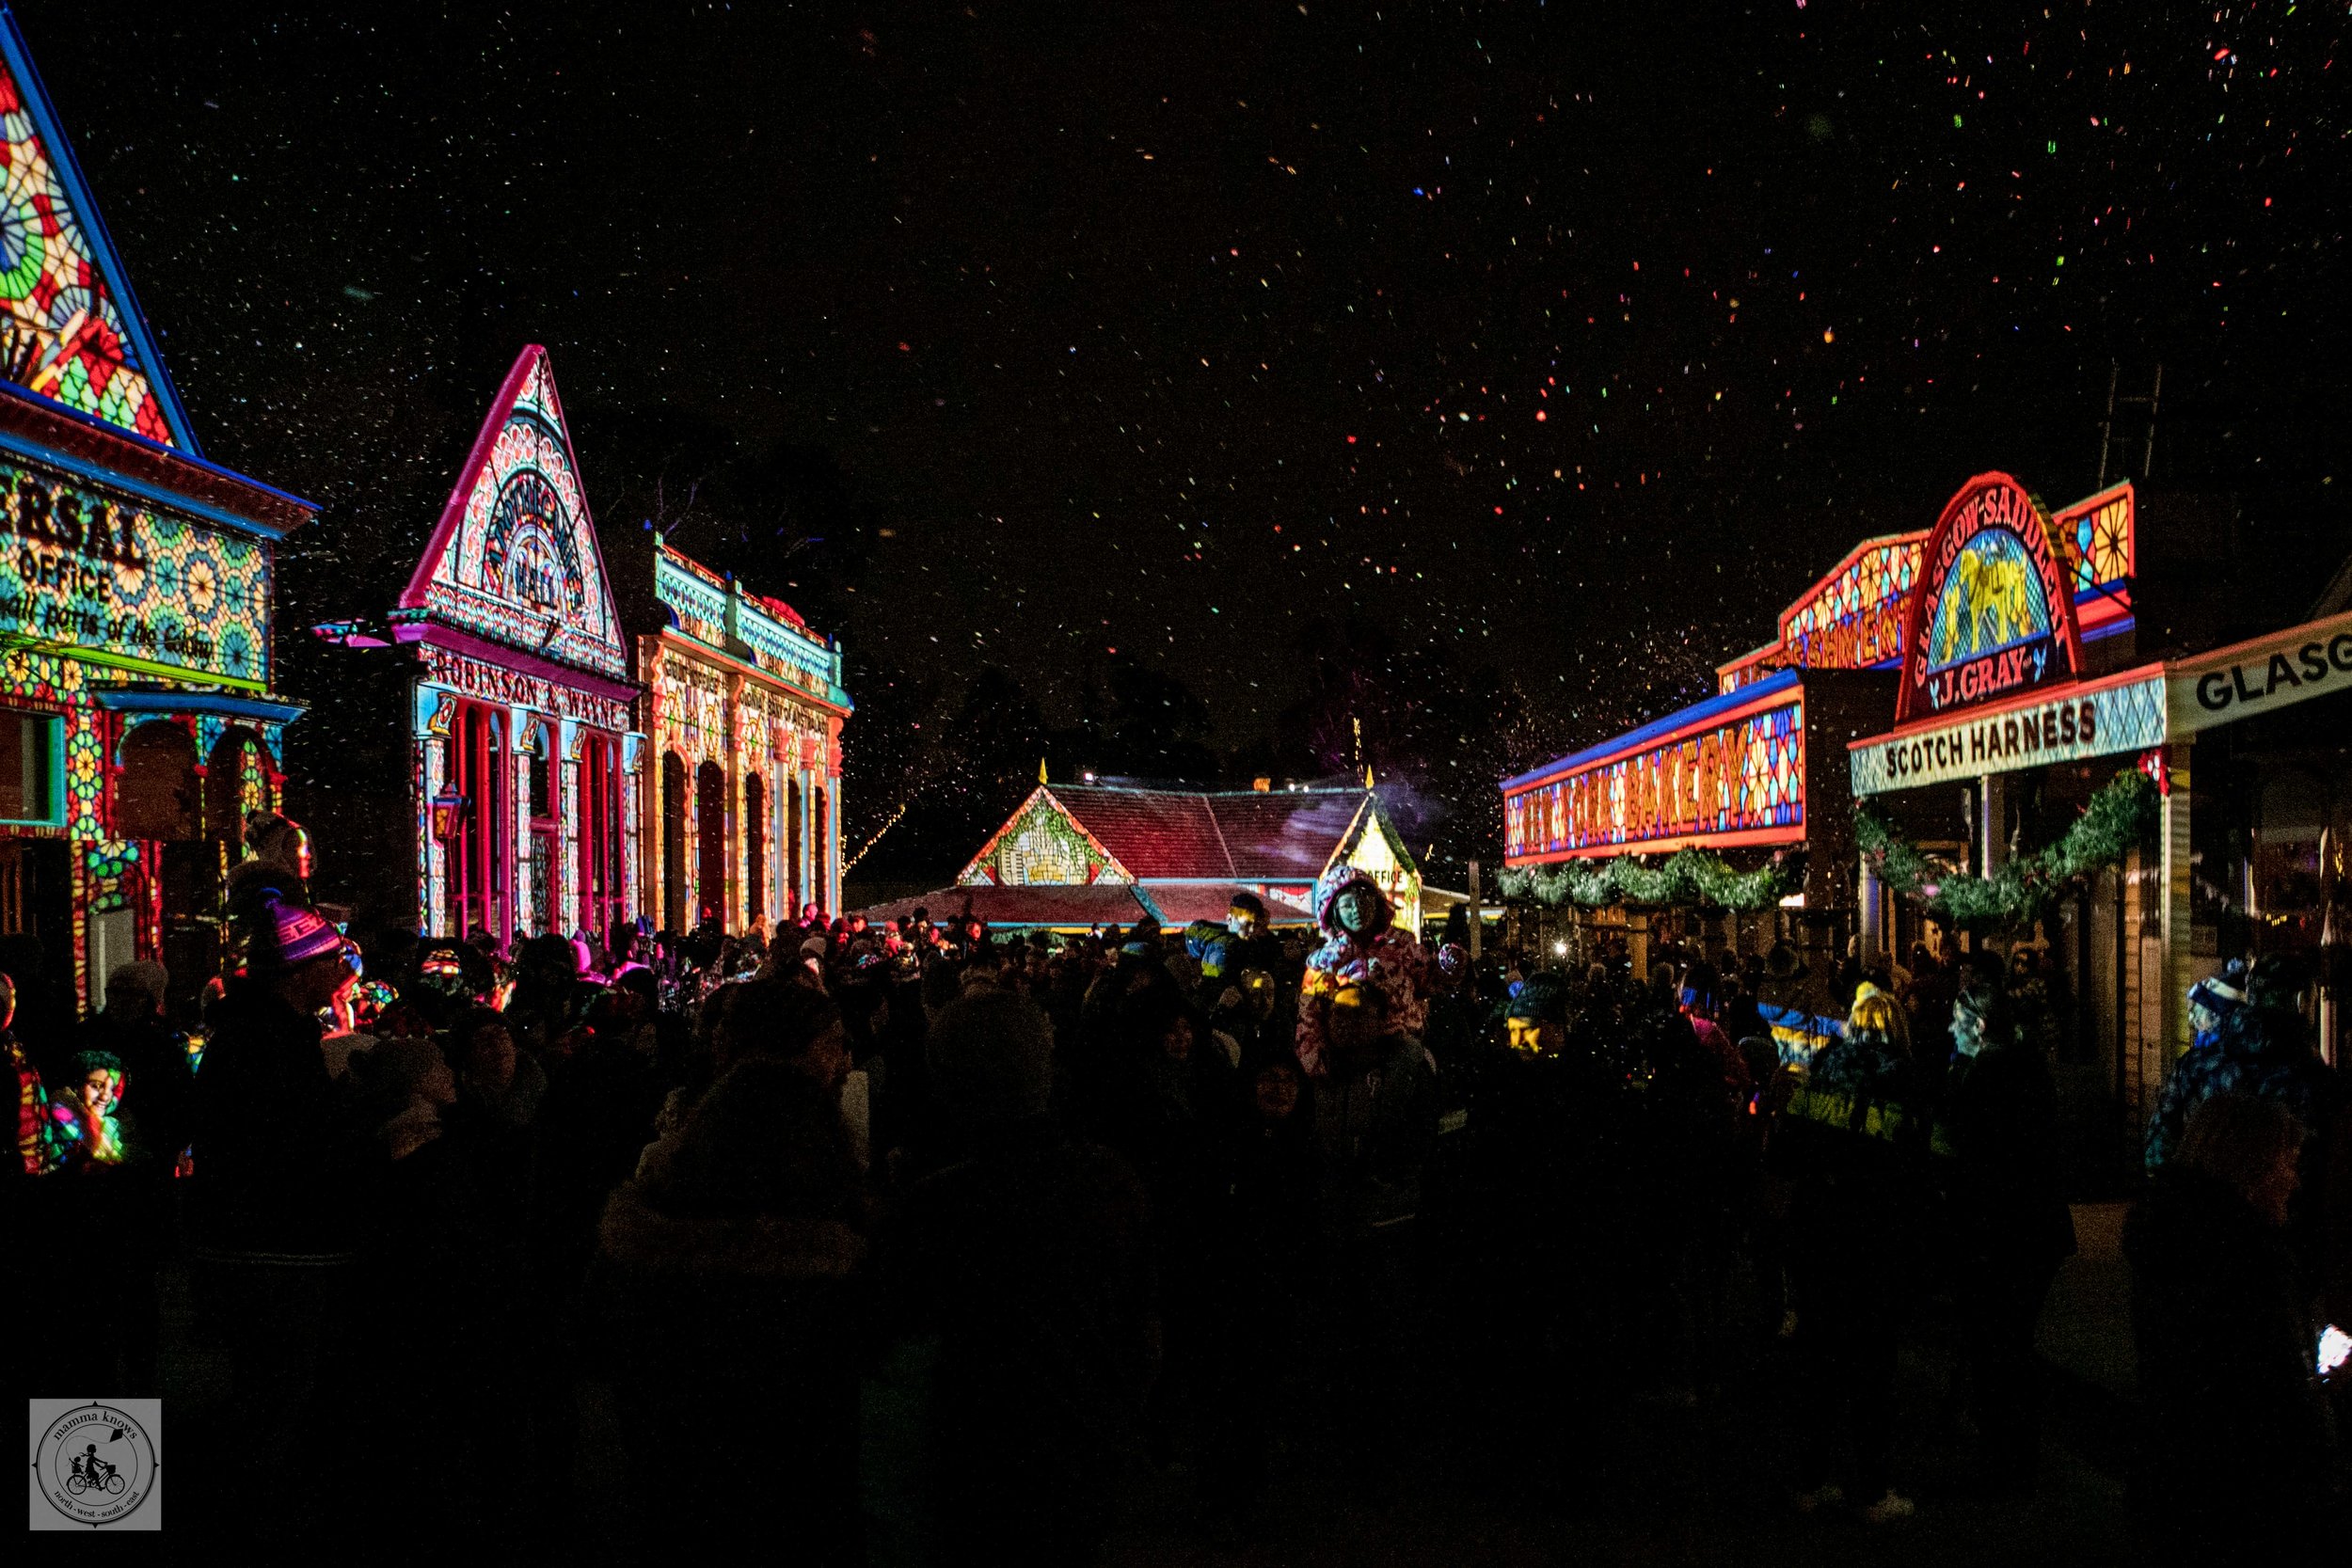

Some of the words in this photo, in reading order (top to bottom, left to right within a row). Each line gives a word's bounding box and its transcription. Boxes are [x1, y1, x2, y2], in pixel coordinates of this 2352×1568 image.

[19, 548, 112, 603] OFFICE
[435, 652, 535, 706] ROBINSON
[2196, 633, 2352, 711] GLASG
[1626, 722, 1752, 834] BAKERY
[1885, 729, 1963, 779] SCOTCH
[1971, 702, 2096, 762] HARNESS
